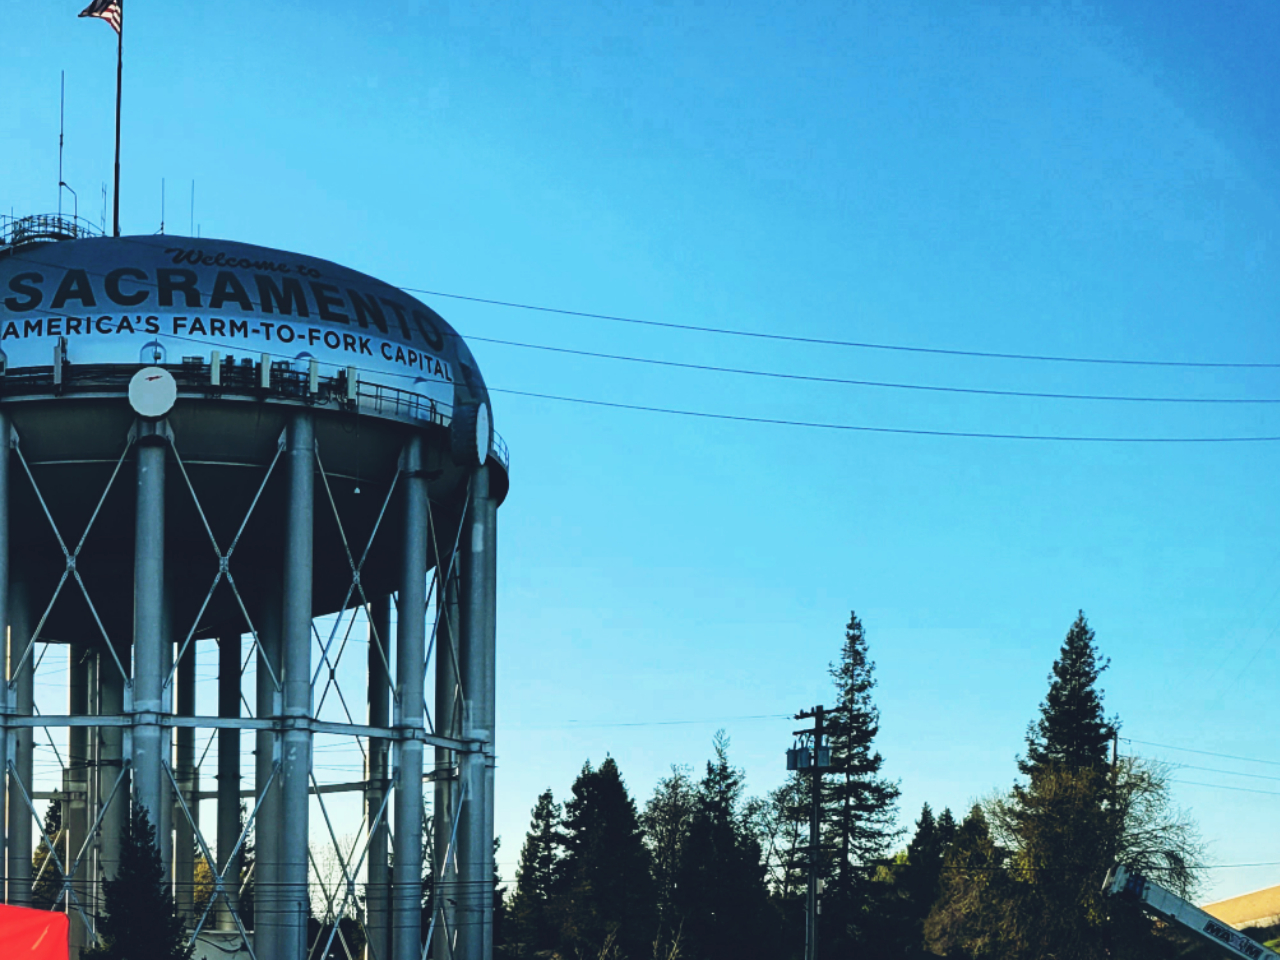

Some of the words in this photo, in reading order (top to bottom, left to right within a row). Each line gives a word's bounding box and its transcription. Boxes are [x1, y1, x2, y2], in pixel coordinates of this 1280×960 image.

[165, 247, 291, 273] Welcome
[295, 264, 323, 279] to
[4, 267, 444, 353] SACRAMENTO
[1, 315, 160, 341] AMERICA'S
[173, 316, 374, 357] FARM-TO-FORK
[380, 341, 453, 382] CAPITAL
